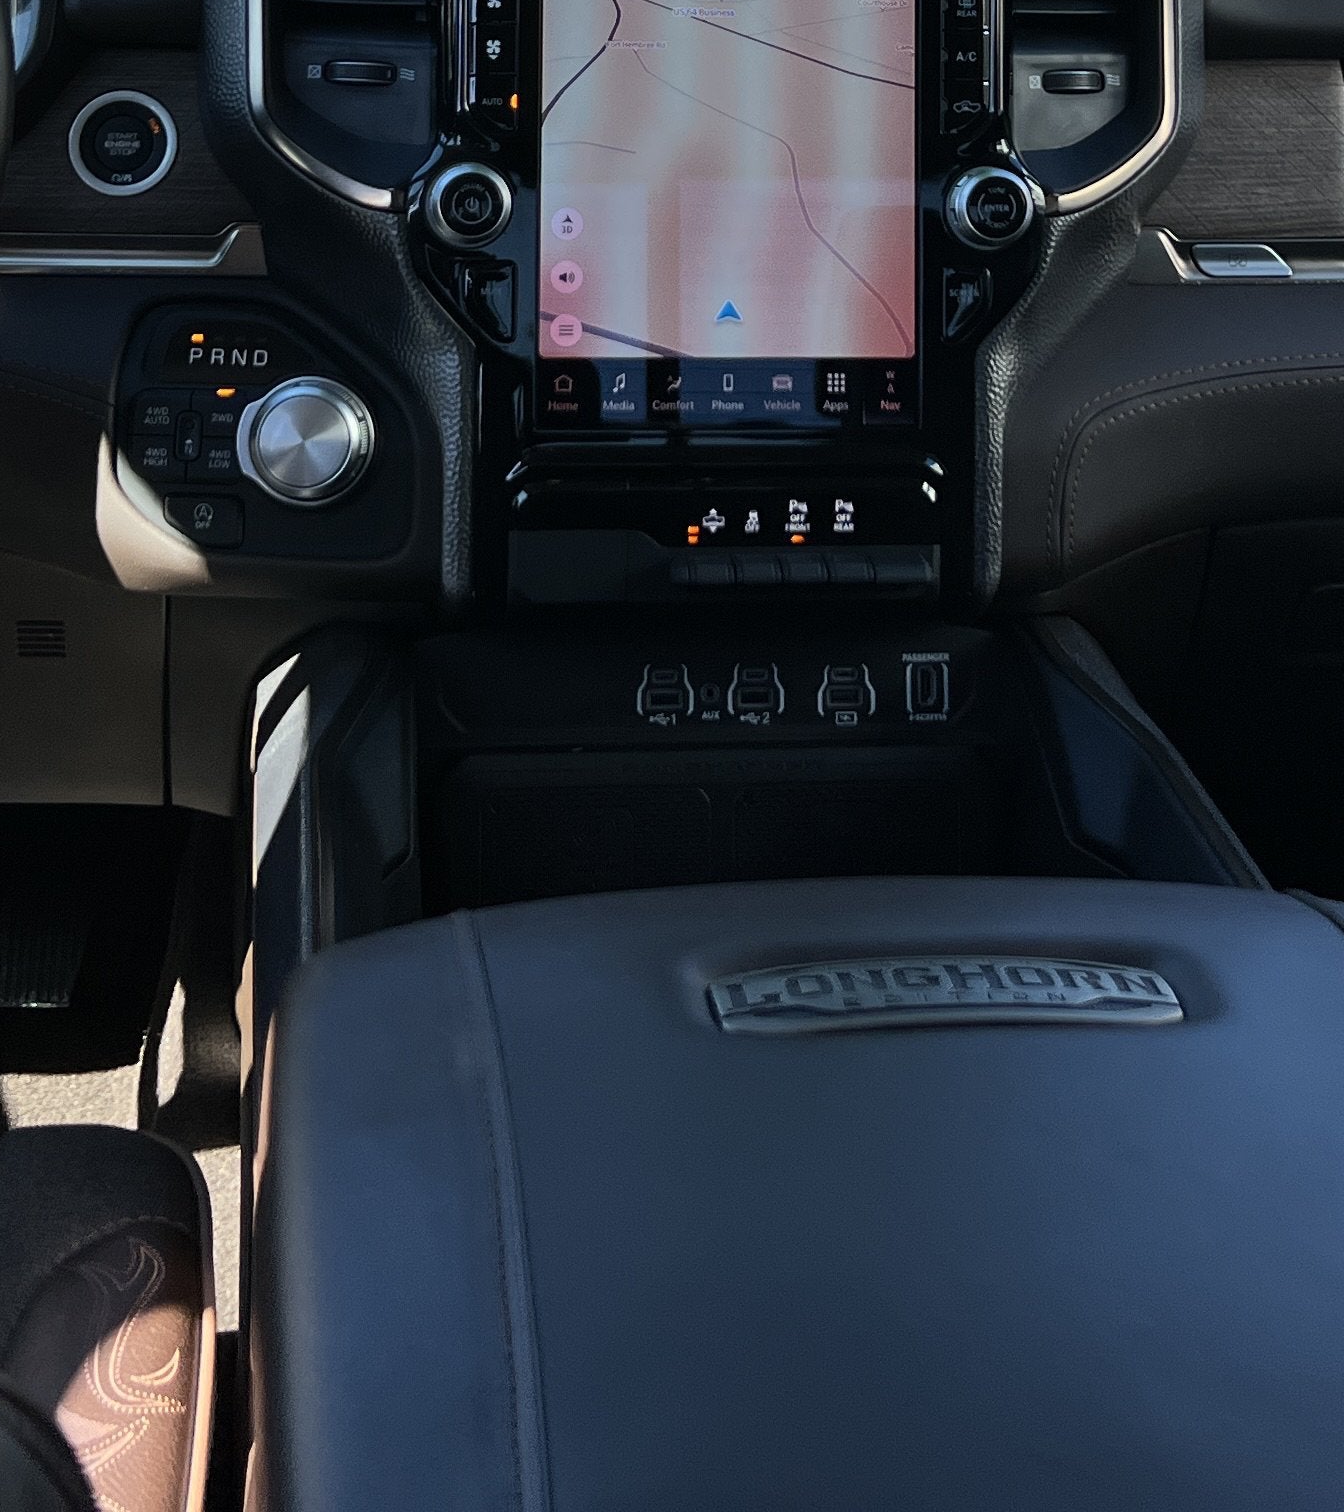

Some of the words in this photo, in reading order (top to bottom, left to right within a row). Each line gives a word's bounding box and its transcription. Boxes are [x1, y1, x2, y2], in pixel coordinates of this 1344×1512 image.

[956, 10, 978, 18] REAR
[956, 51, 978, 62] A/C
[482, 98, 503, 106] AUTO
[107, 132, 138, 140] START
[104, 140, 141, 148] ENGINE
[109, 147, 137, 156] STOP
[984, 203, 1010, 212] ENTER
[561, 225, 573, 234] 3D
[548, 399, 579, 411] Home
[602, 399, 635, 411] Media
[652, 399, 695, 411] Comfort
[711, 399, 744, 411] Phone
[763, 399, 801, 411] Vehicle
[823, 399, 849, 413] Apps
[880, 399, 901, 411] Nav
[145, 406, 169, 415] 4WD
[144, 415, 170, 425] AUTO
[211, 412, 234, 423] 2WD
[145, 447, 168, 457] 4WD
[209, 449, 231, 459] 4WD
[144, 457, 168, 467] HIGH
[208, 459, 231, 469] LOW
[195, 520, 210, 529] OFF
[902, 652, 950, 662] PASSENGER
[701, 711, 721, 721] AUX
[725, 962, 1171, 1009] LONGHORN
